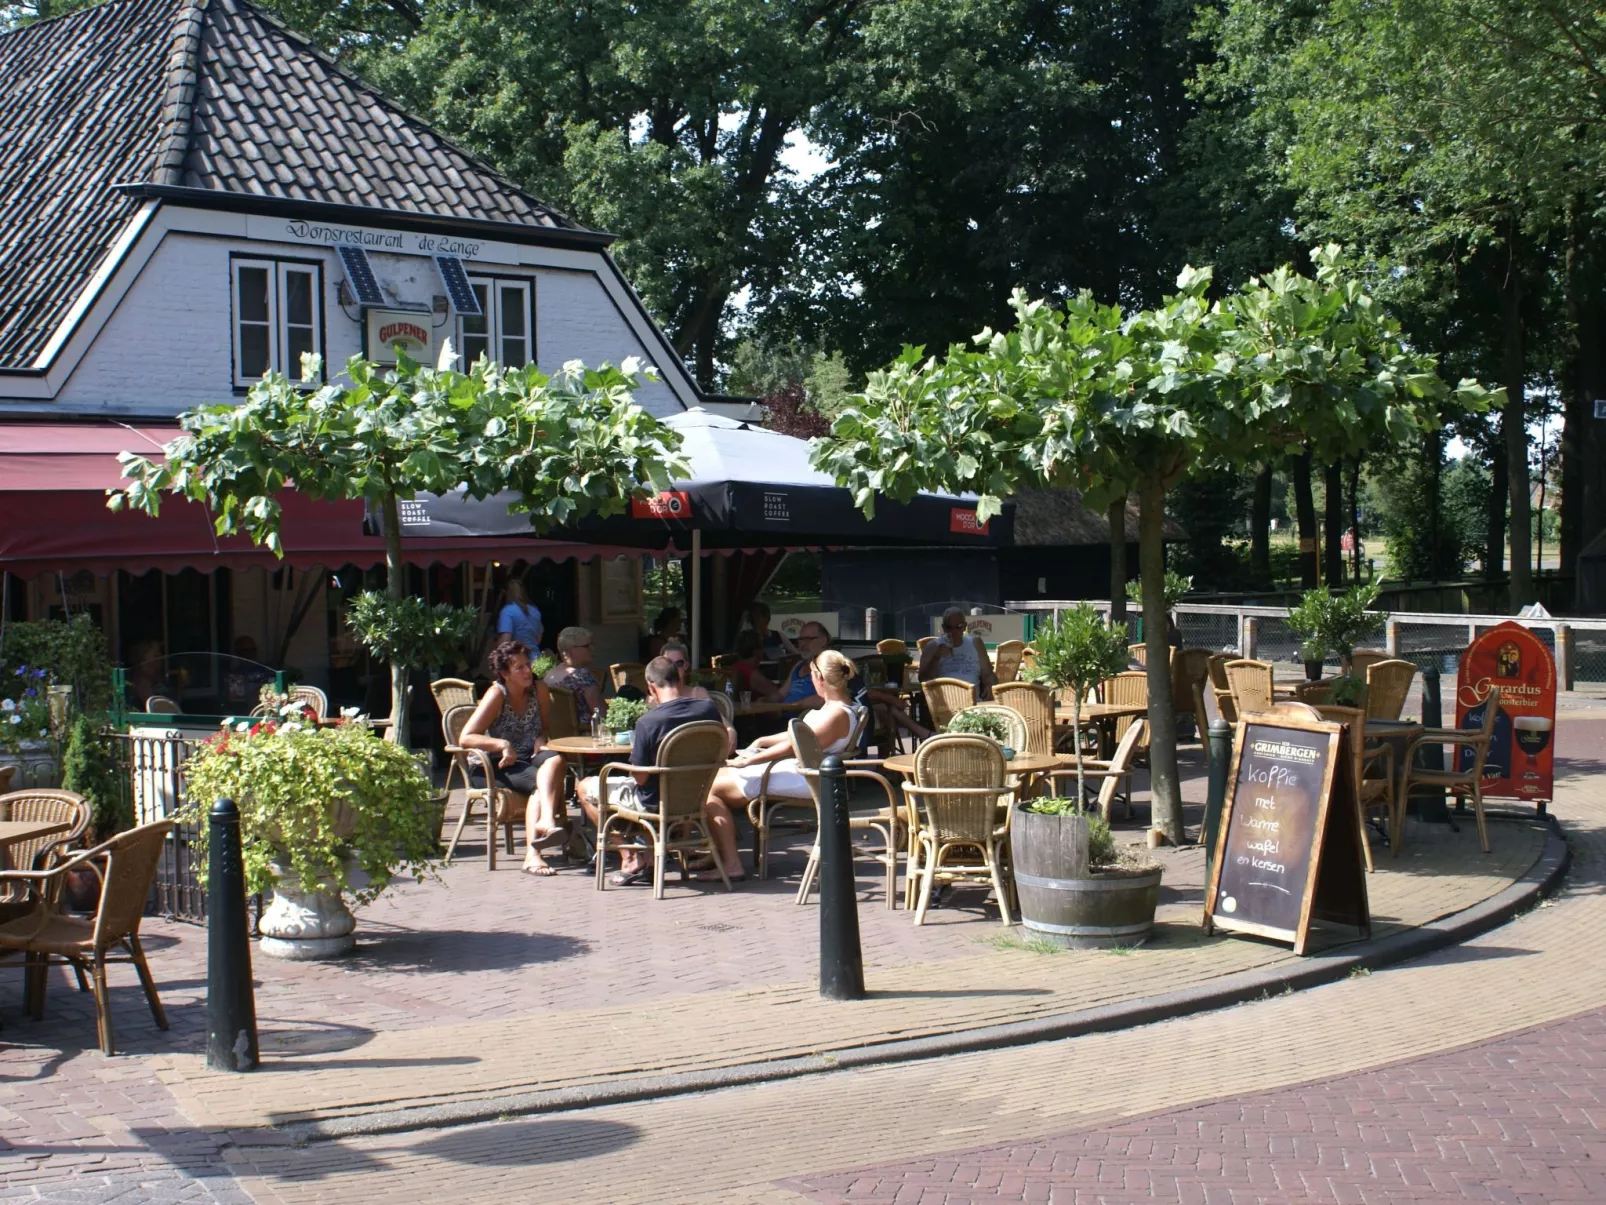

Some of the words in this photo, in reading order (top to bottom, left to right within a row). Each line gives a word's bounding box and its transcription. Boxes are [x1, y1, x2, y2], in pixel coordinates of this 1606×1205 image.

[286, 219, 404, 248] Dorpsrestaurant
[379, 321, 428, 346] GULPENER
[956, 513, 975, 521] MOCCA
[968, 619, 993, 633] GULPENER
[1498, 698, 1539, 707] oosterbier
[1254, 742, 1317, 759] GRIMBERGEN
[1255, 796, 1277, 810] met
[1236, 855, 1250, 865] en
